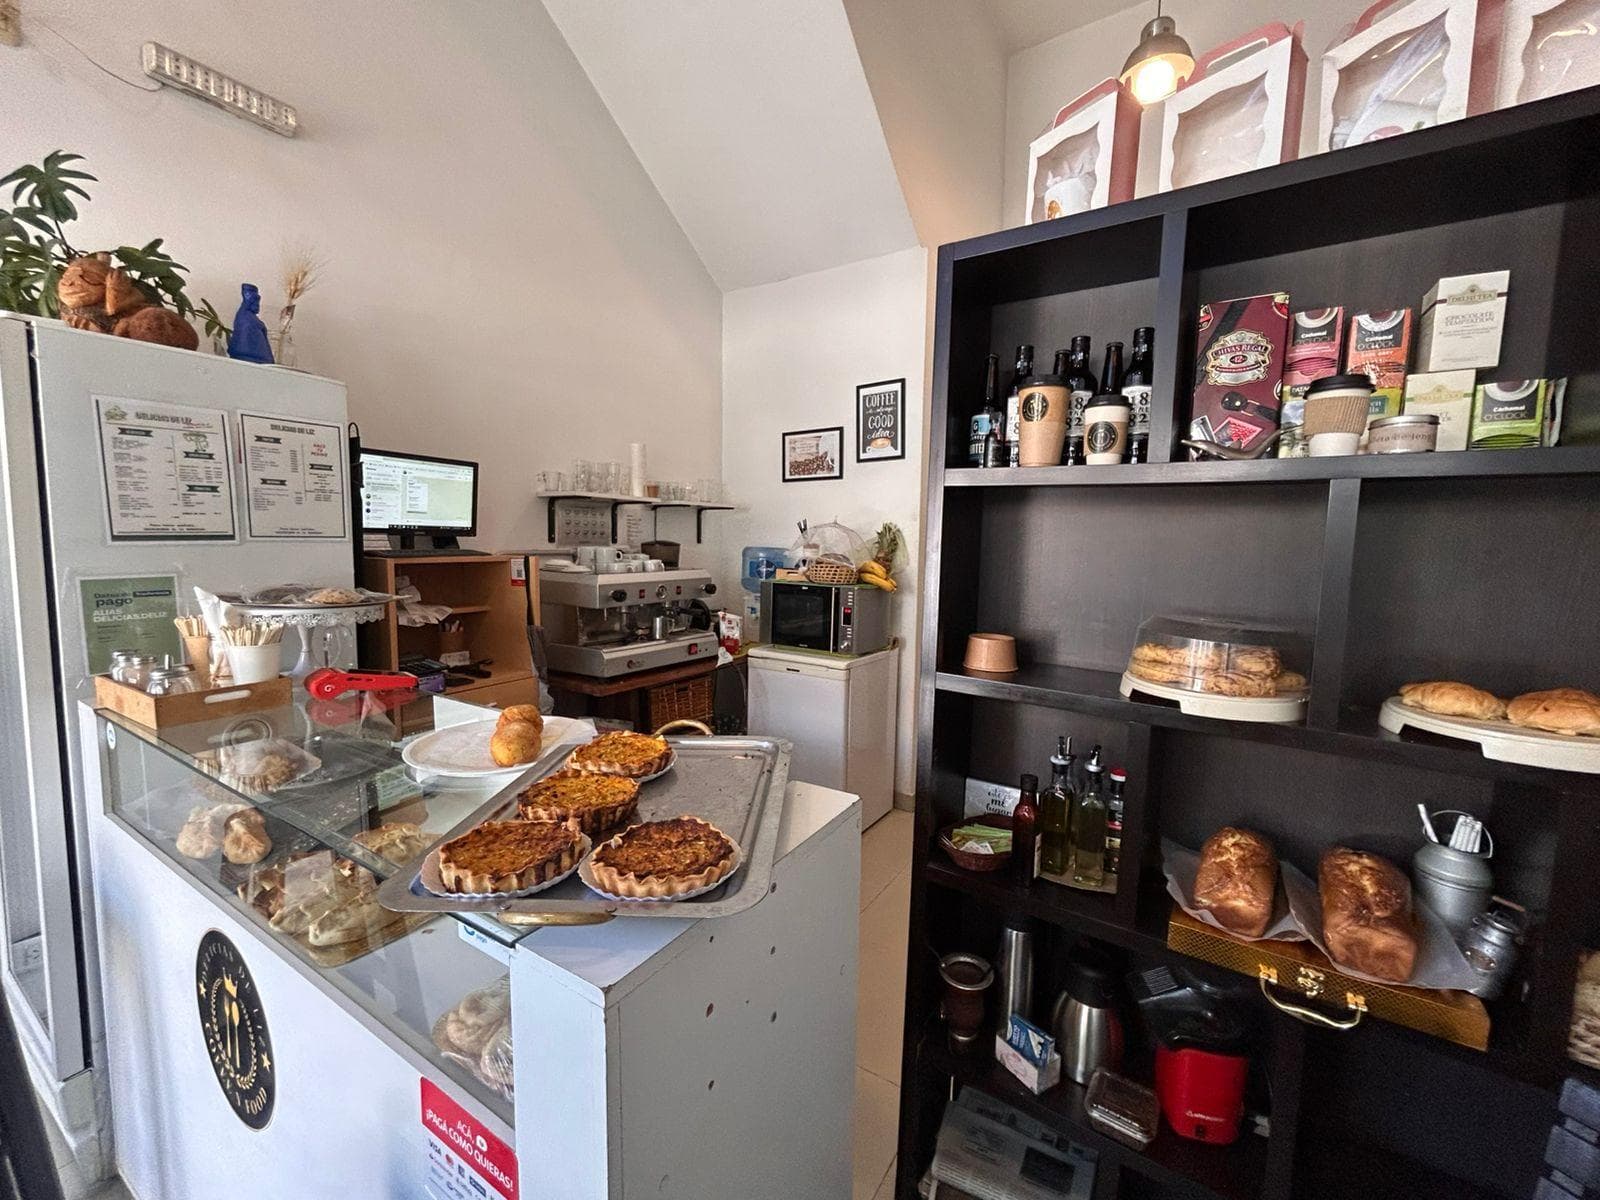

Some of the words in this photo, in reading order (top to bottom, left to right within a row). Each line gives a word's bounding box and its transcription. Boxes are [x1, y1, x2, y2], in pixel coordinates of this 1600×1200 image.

[1212, 345, 1241, 357] CHIVAS
[866, 391, 896, 408] COFFEE
[868, 414, 895, 430] GOOD
[95, 597, 133, 608] pago
[93, 608, 122, 616] ALIAS
[244, 1086, 268, 1115] FOOD
[448, 1128, 474, 1156] COMO
[474, 1150, 514, 1192] QUIERAS!
